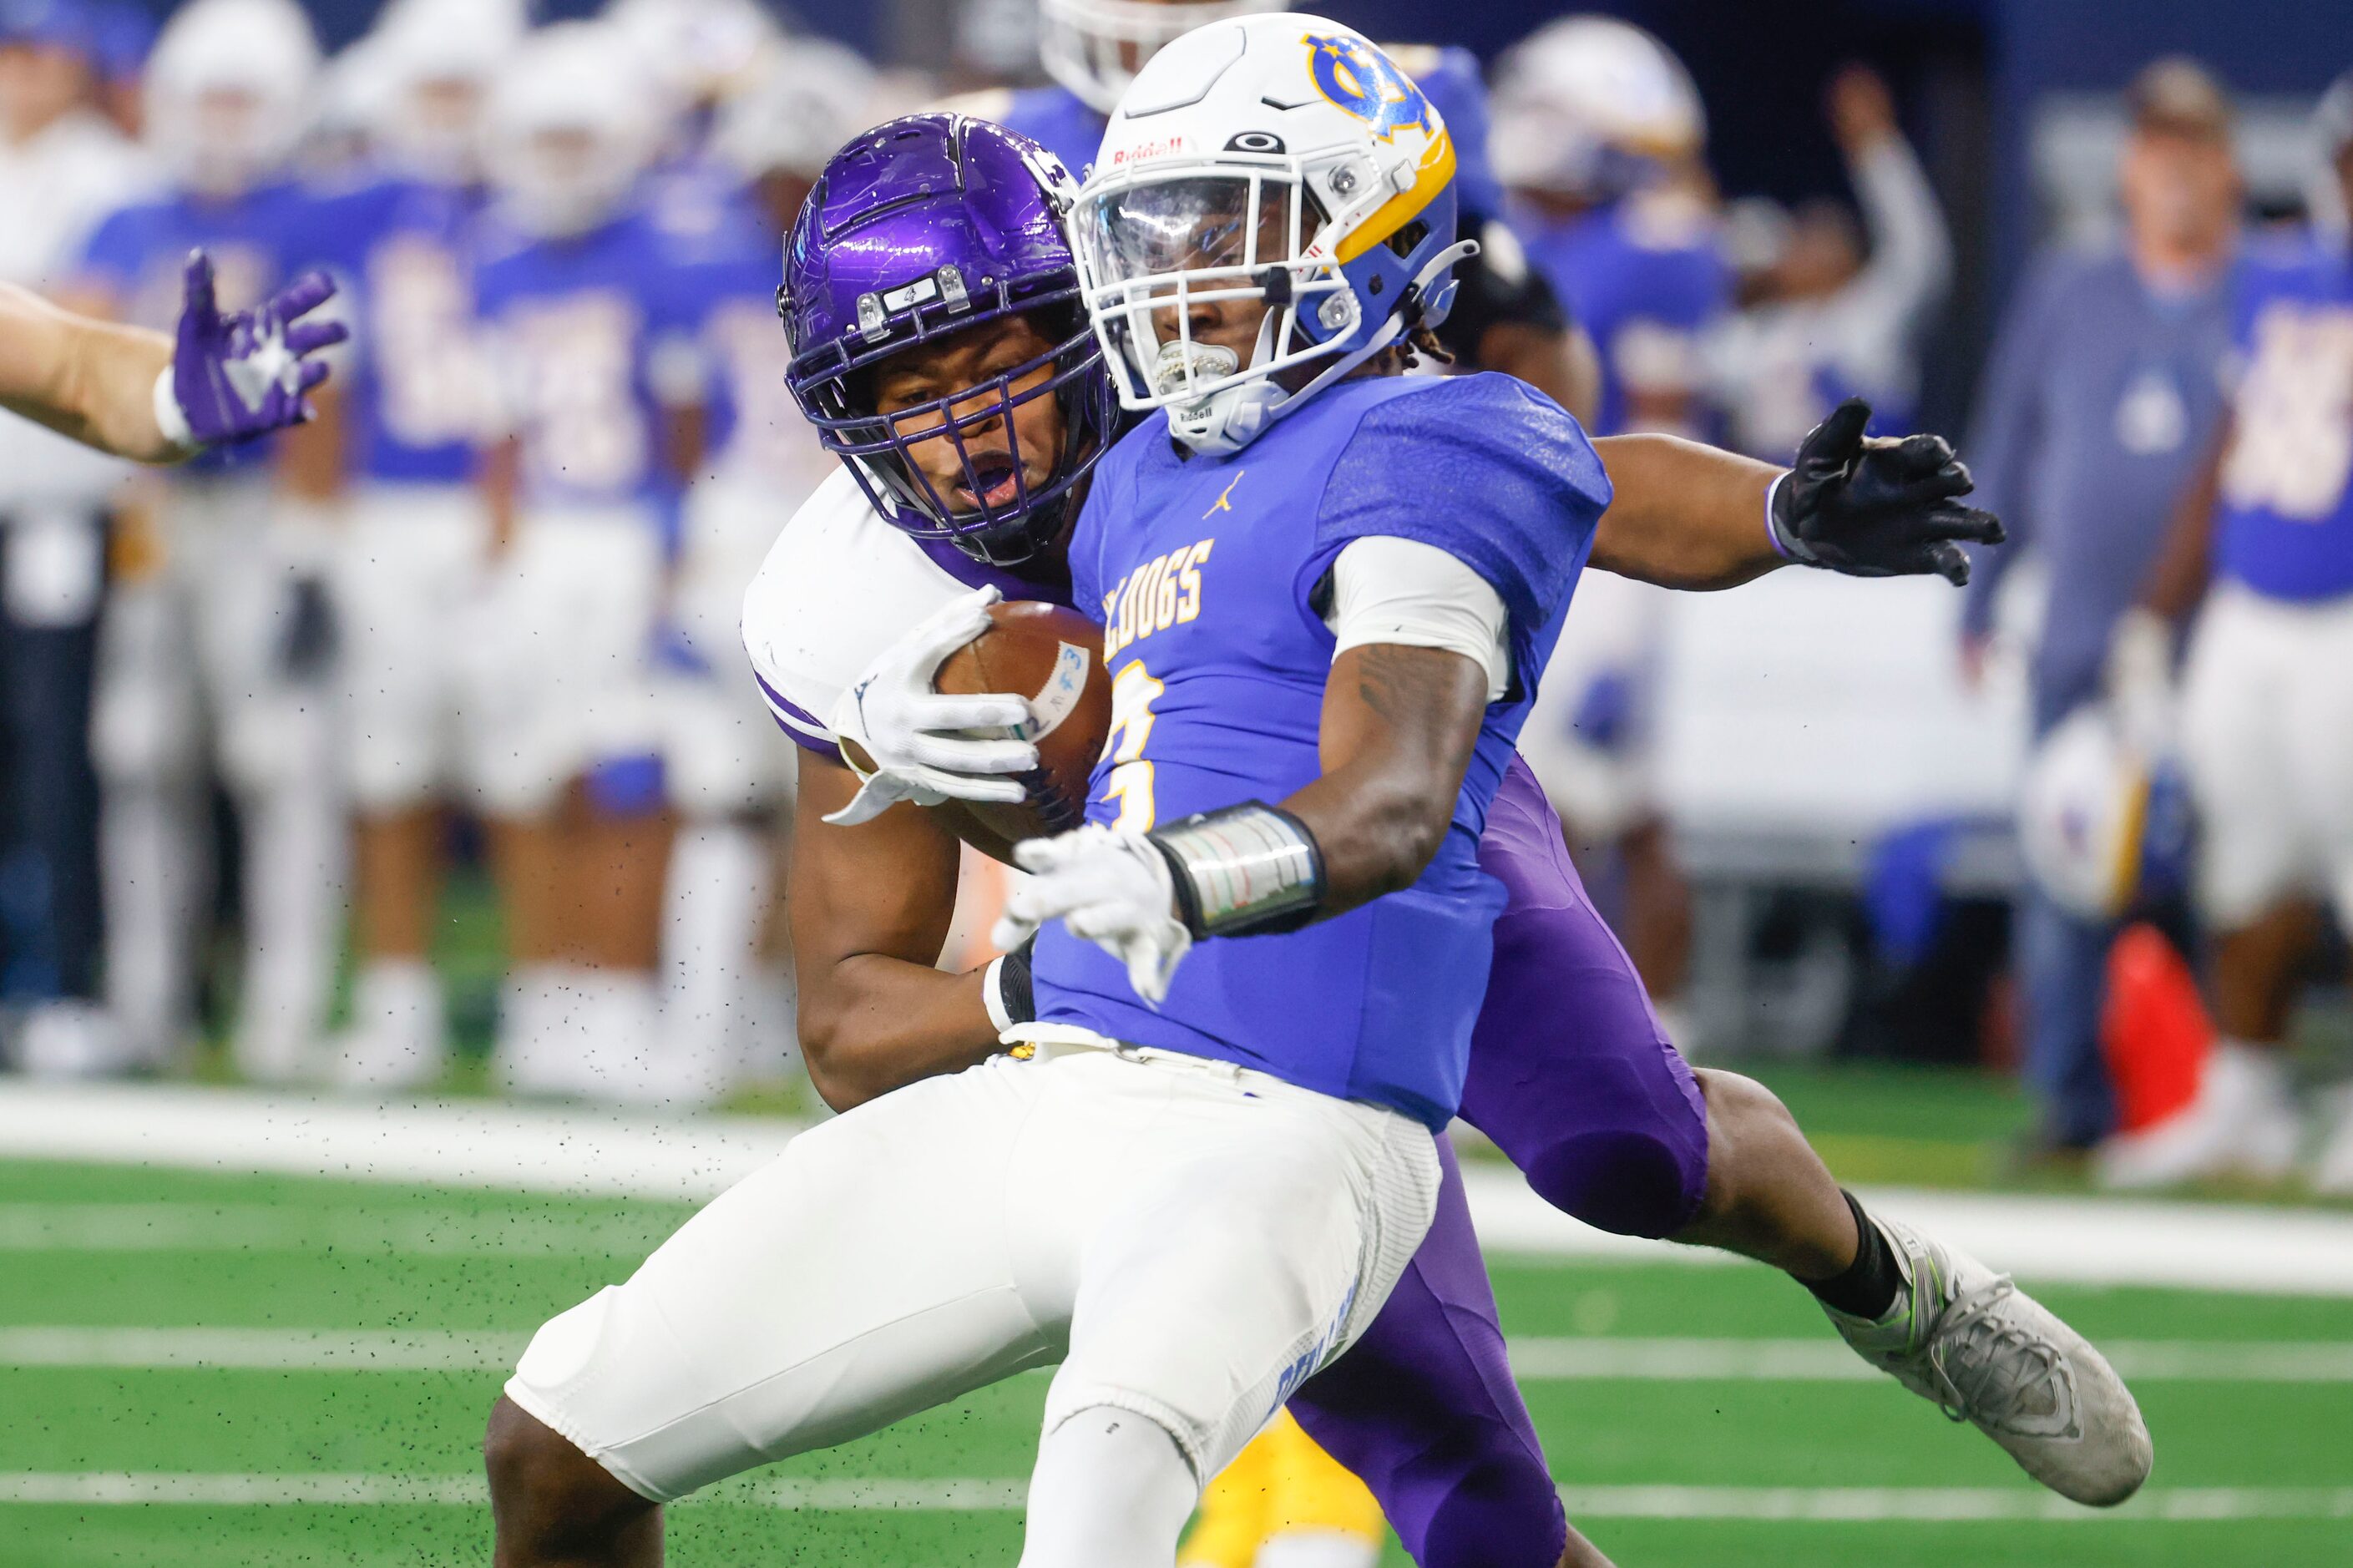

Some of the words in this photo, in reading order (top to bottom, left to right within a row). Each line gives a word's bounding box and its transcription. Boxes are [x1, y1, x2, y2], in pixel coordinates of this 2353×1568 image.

[1114, 137, 1182, 165] Riddell
[1180, 407, 1212, 422] Riddell
[1102, 538, 1216, 663] LDOGS
